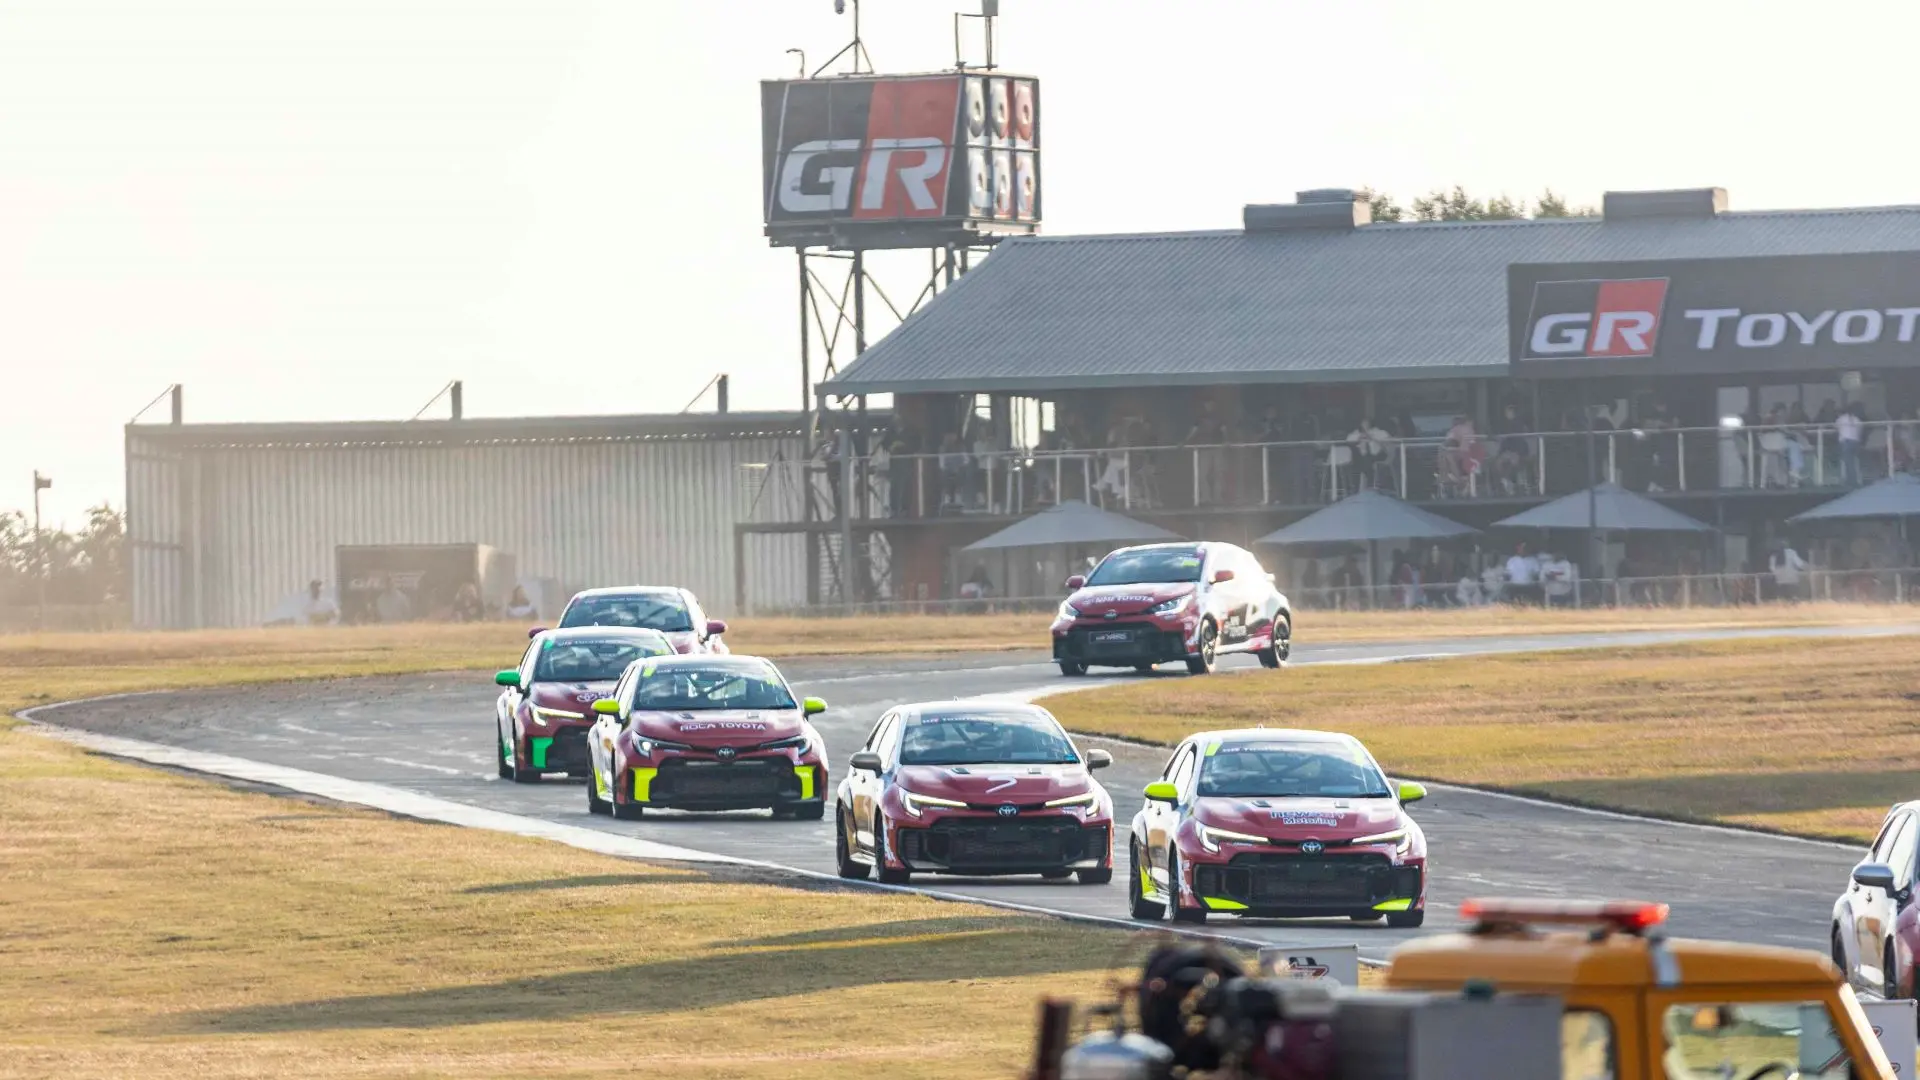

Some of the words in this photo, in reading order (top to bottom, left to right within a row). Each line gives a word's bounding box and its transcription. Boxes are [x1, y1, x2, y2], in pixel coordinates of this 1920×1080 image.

[779, 136, 946, 212] GR
[1530, 310, 1656, 353] GR
[1684, 307, 1920, 349] TOYOT
[1117, 594, 1155, 602] TOYOTA
[720, 722, 766, 730] TOYOTA
[1282, 817, 1338, 827] Motoring
